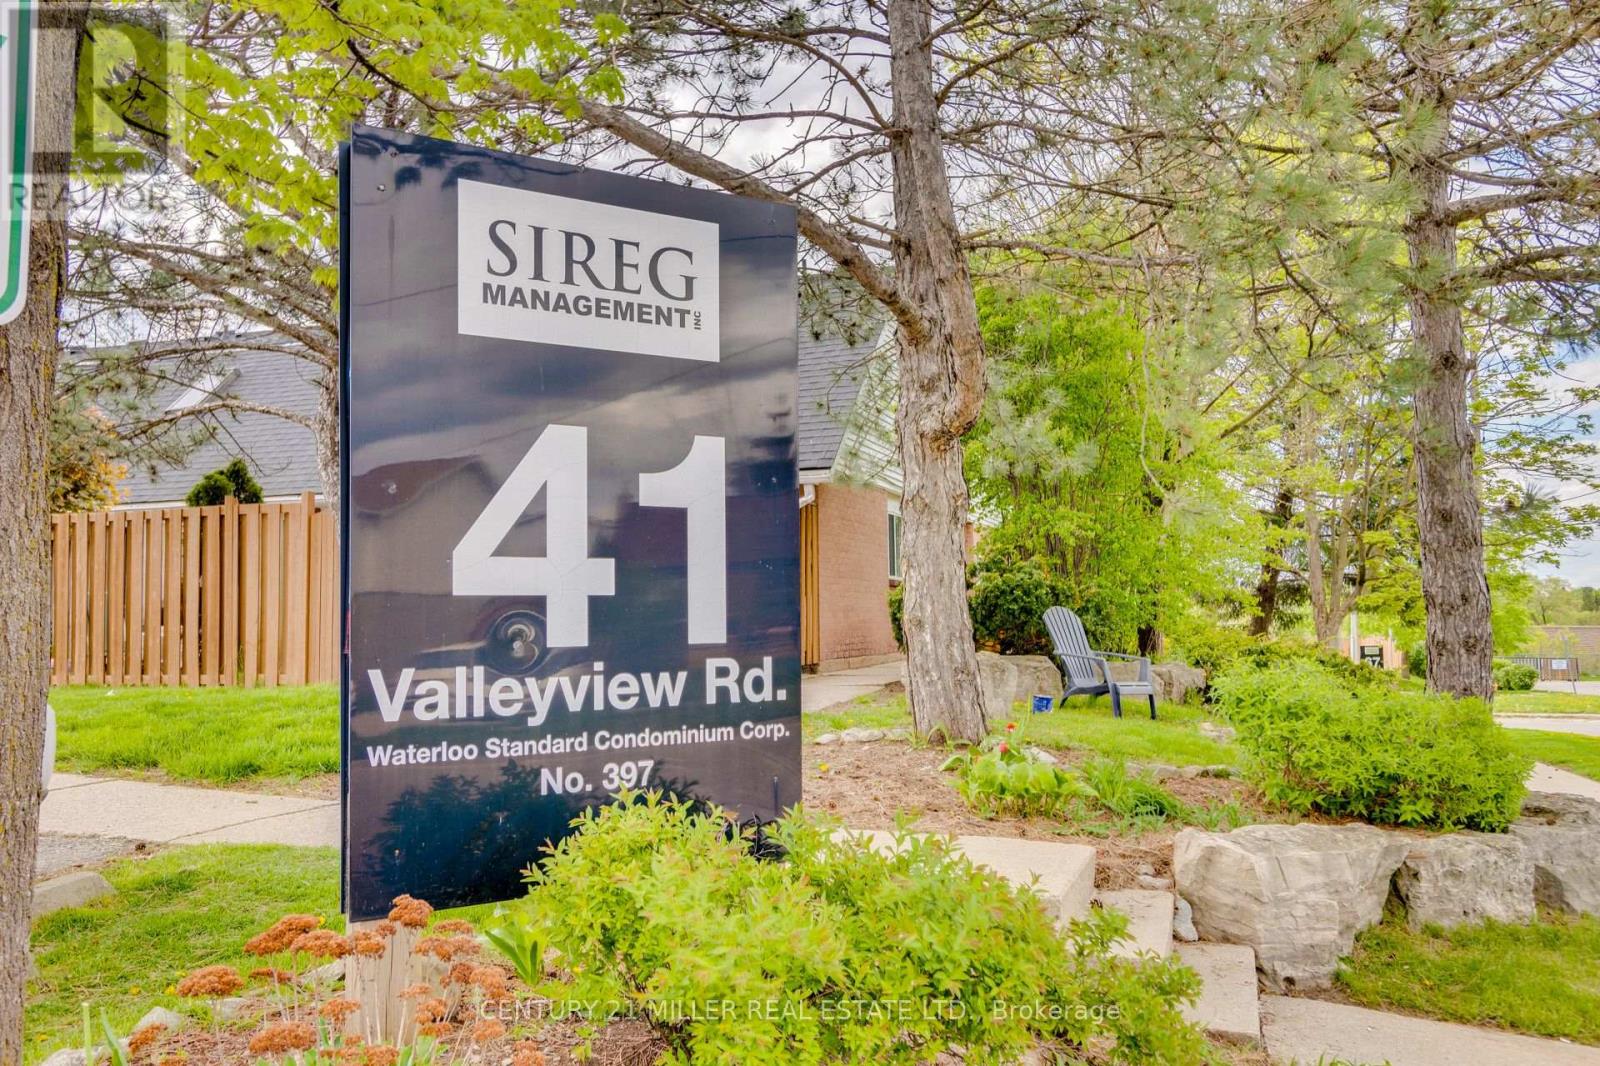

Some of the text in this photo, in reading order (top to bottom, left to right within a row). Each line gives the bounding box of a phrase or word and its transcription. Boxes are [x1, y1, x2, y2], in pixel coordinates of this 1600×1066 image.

[487, 219, 698, 302] SIREG
[482, 282, 691, 329] MANAGEMENT
[452, 423, 727, 648] 41
[367, 656, 787, 727] Valleyview Rd.
[366, 720, 790, 767] Waterloo Standard Condominium Corp.
[540, 760, 654, 795] No. 397
